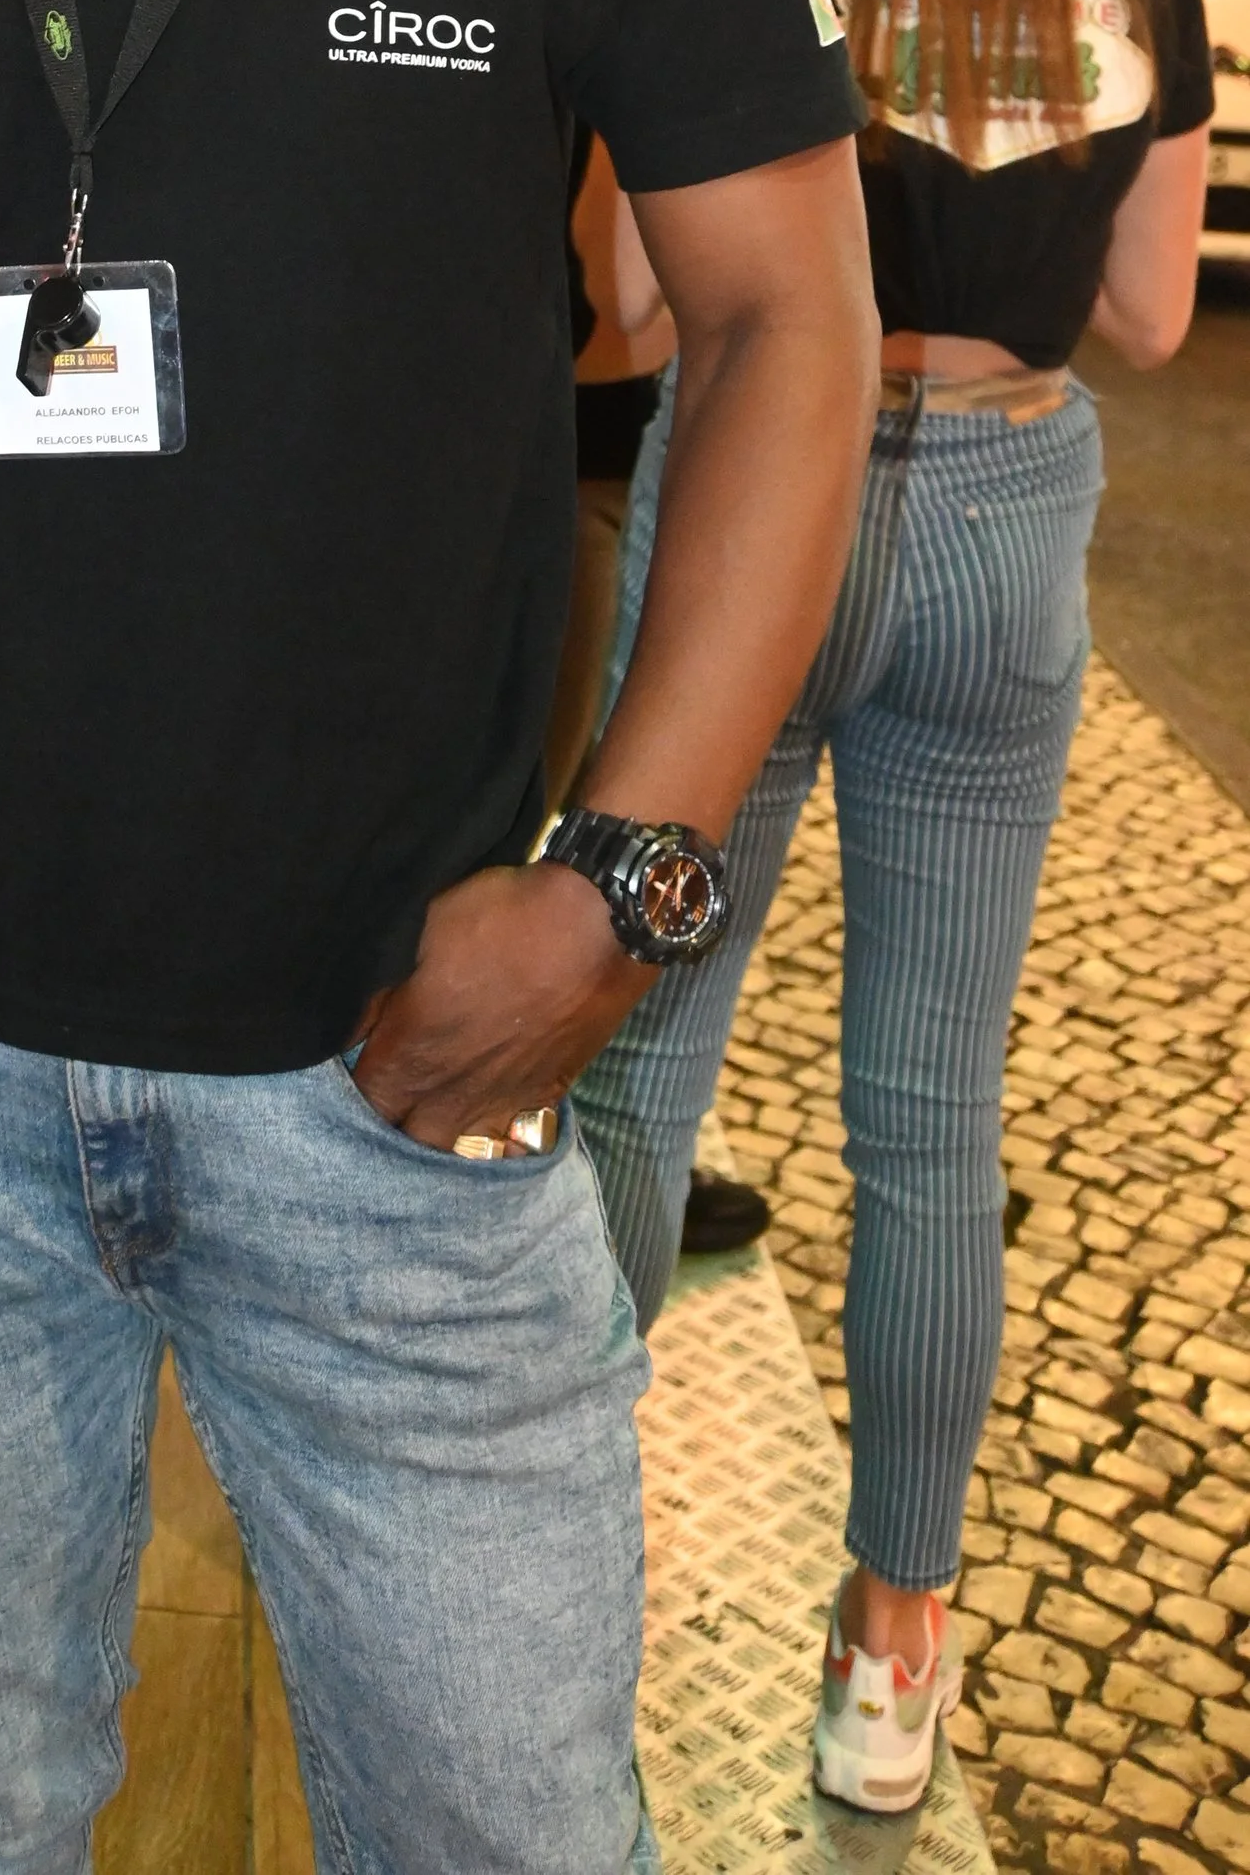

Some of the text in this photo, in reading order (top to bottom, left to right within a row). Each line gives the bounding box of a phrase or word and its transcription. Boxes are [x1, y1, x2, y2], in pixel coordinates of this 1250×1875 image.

[328, 0, 496, 54] CÎROC
[328, 48, 491, 73] ULTRA PREMIUM VODKA
[54, 352, 115, 366] BEER & MUSIC
[36, 406, 140, 417] ALEJAANDRO EFOH
